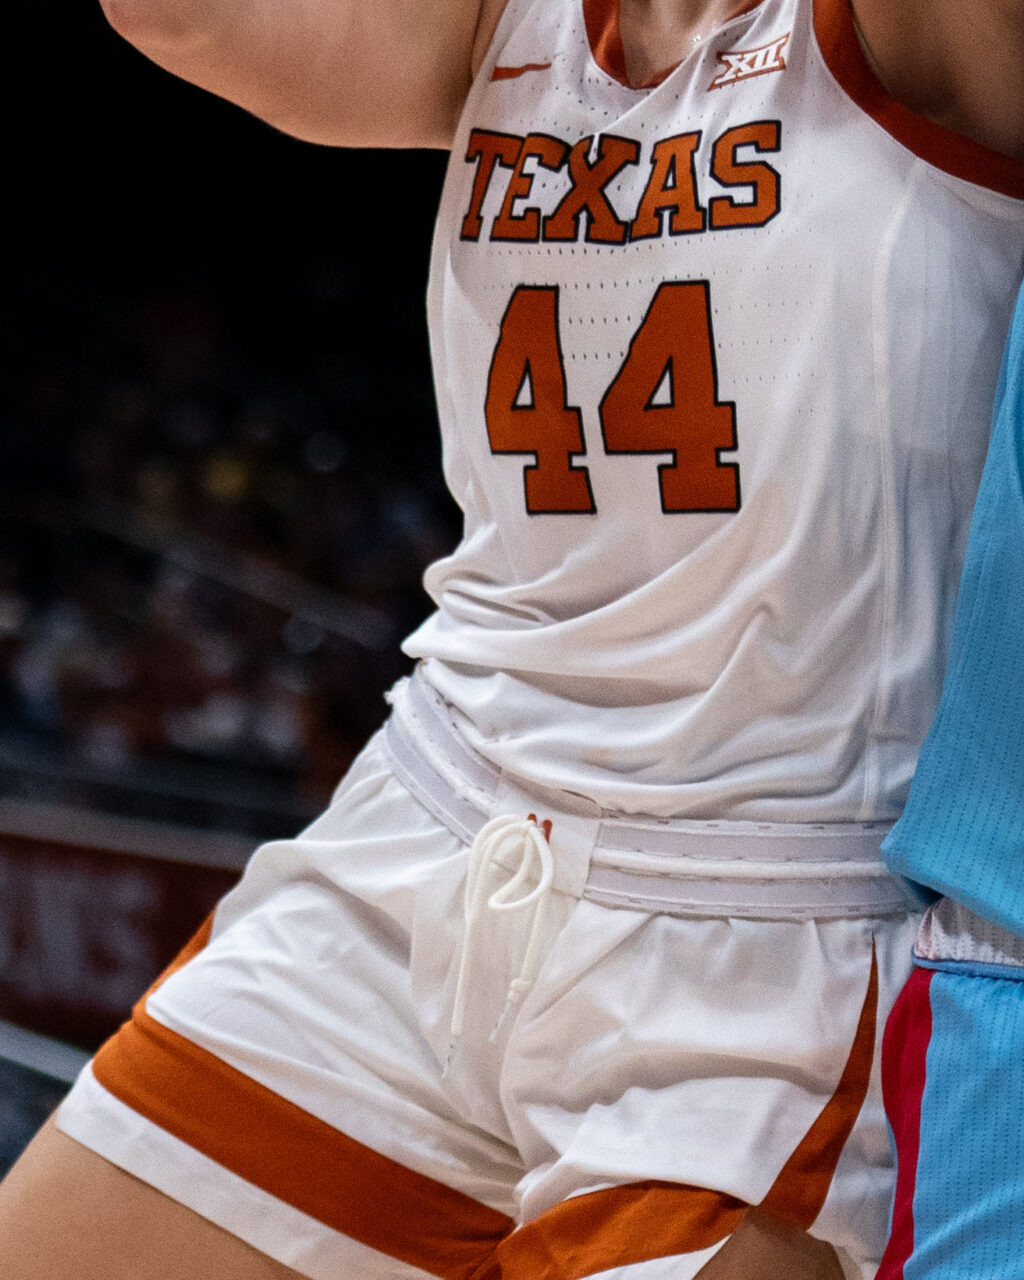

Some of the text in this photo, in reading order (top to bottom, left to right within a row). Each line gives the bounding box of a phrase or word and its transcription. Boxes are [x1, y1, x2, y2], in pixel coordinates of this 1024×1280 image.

[709, 36, 790, 88] XII
[460, 120, 782, 245] TEXAS
[484, 280, 742, 515] 44
